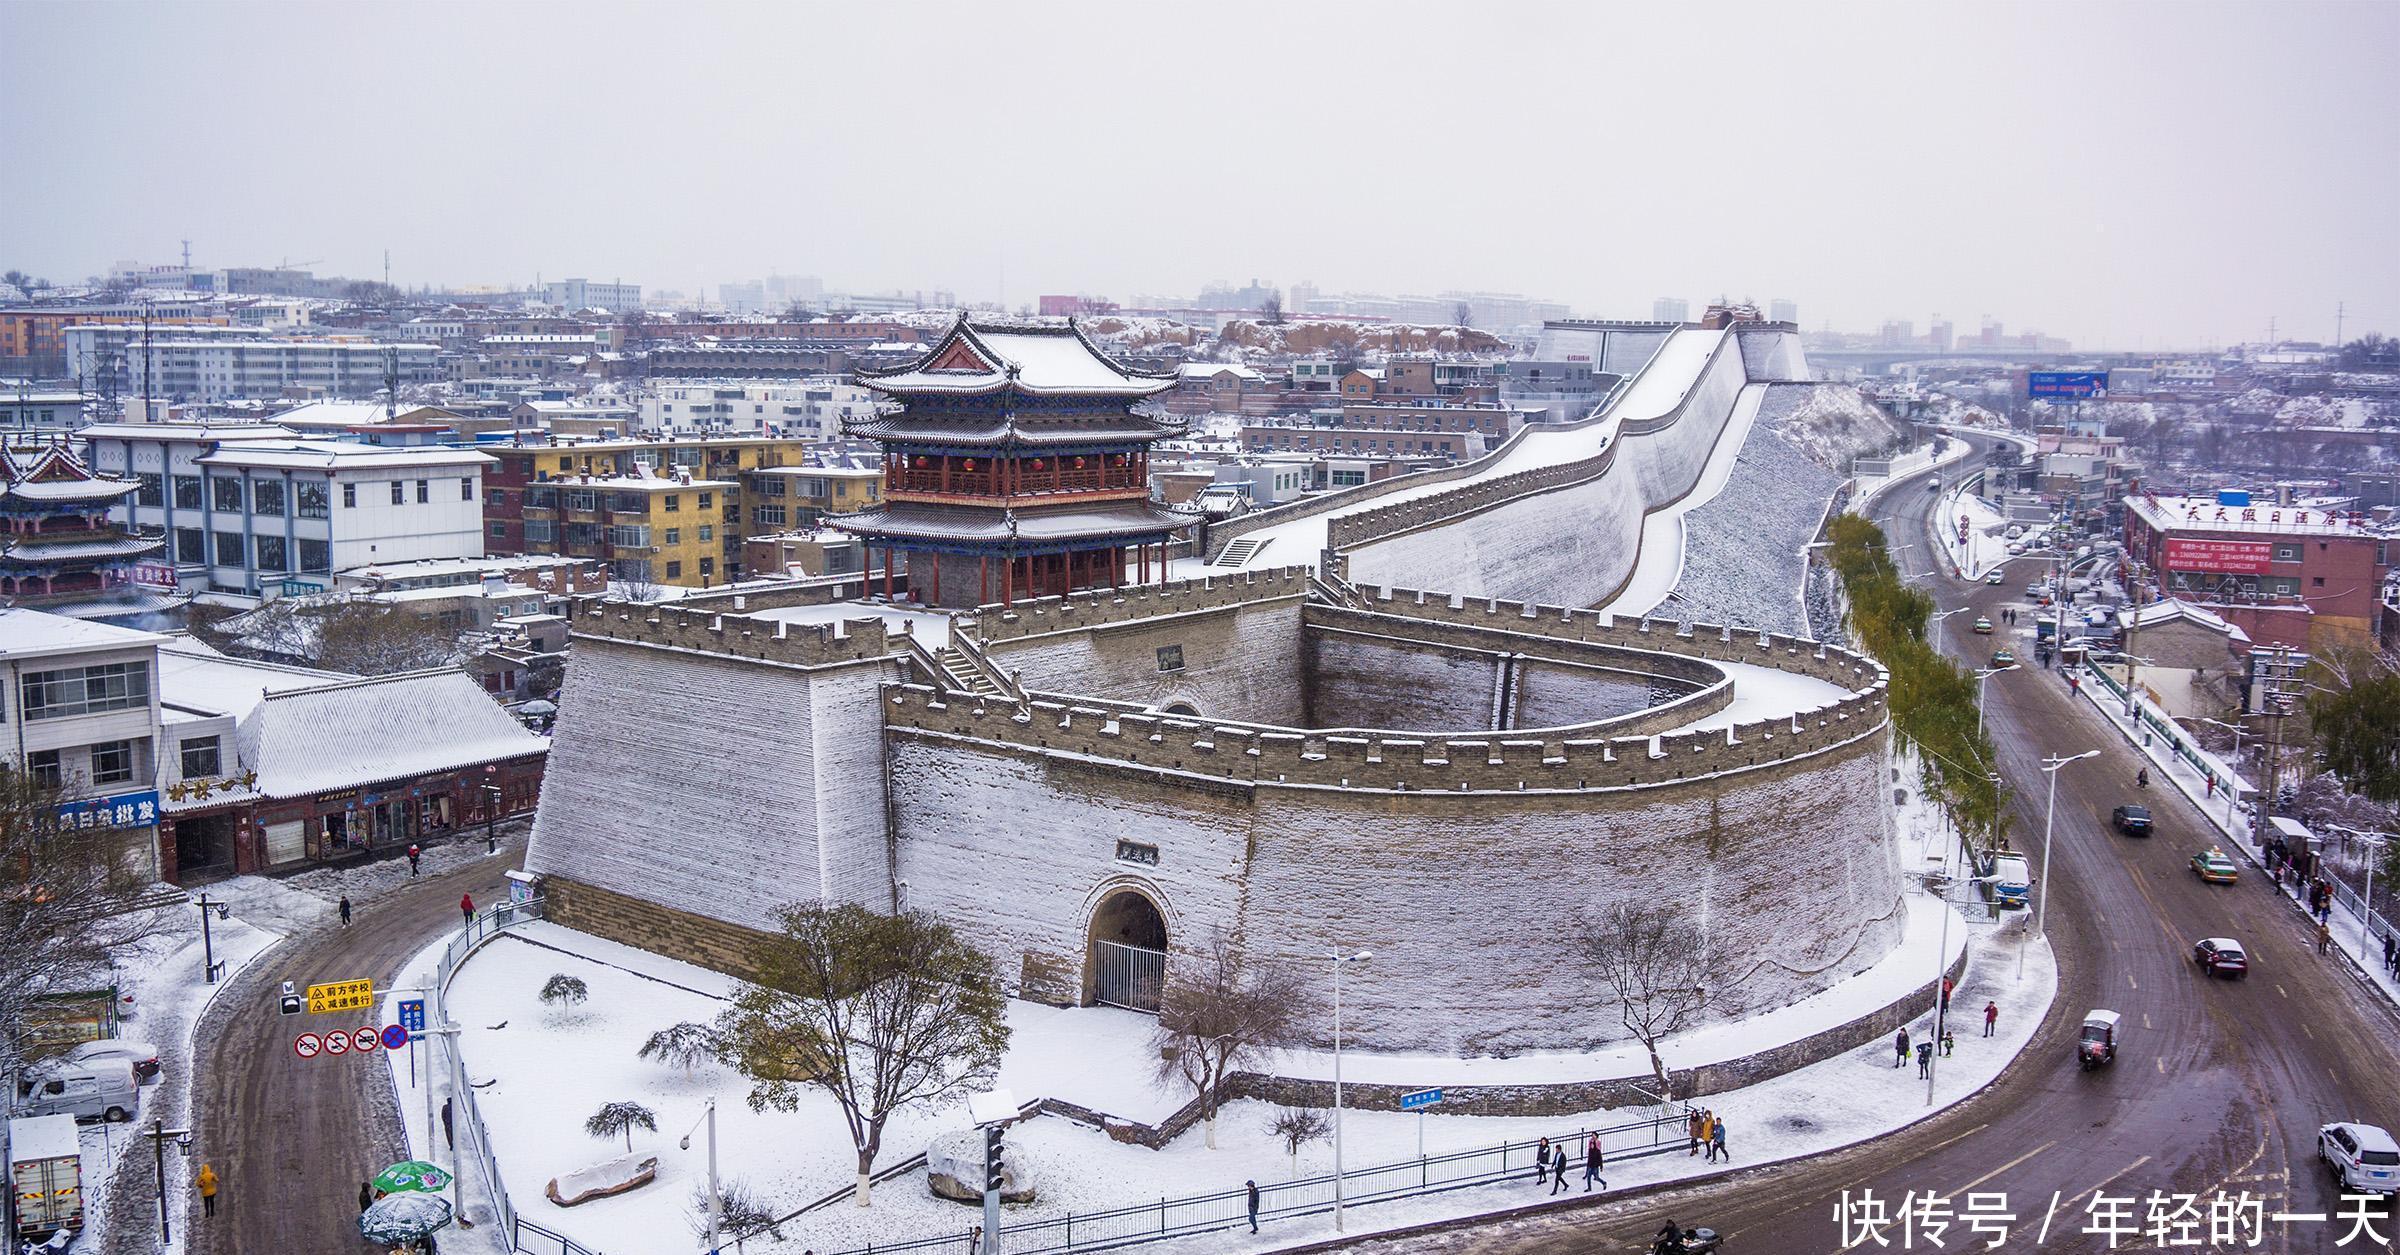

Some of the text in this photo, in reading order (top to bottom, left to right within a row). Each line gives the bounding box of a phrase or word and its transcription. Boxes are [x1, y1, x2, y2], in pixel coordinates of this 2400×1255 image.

[2187, 506, 2336, 526] 天天假日酒店
[327, 983, 369, 997] 前方学校
[328, 996, 370, 1009] 减速慢行
